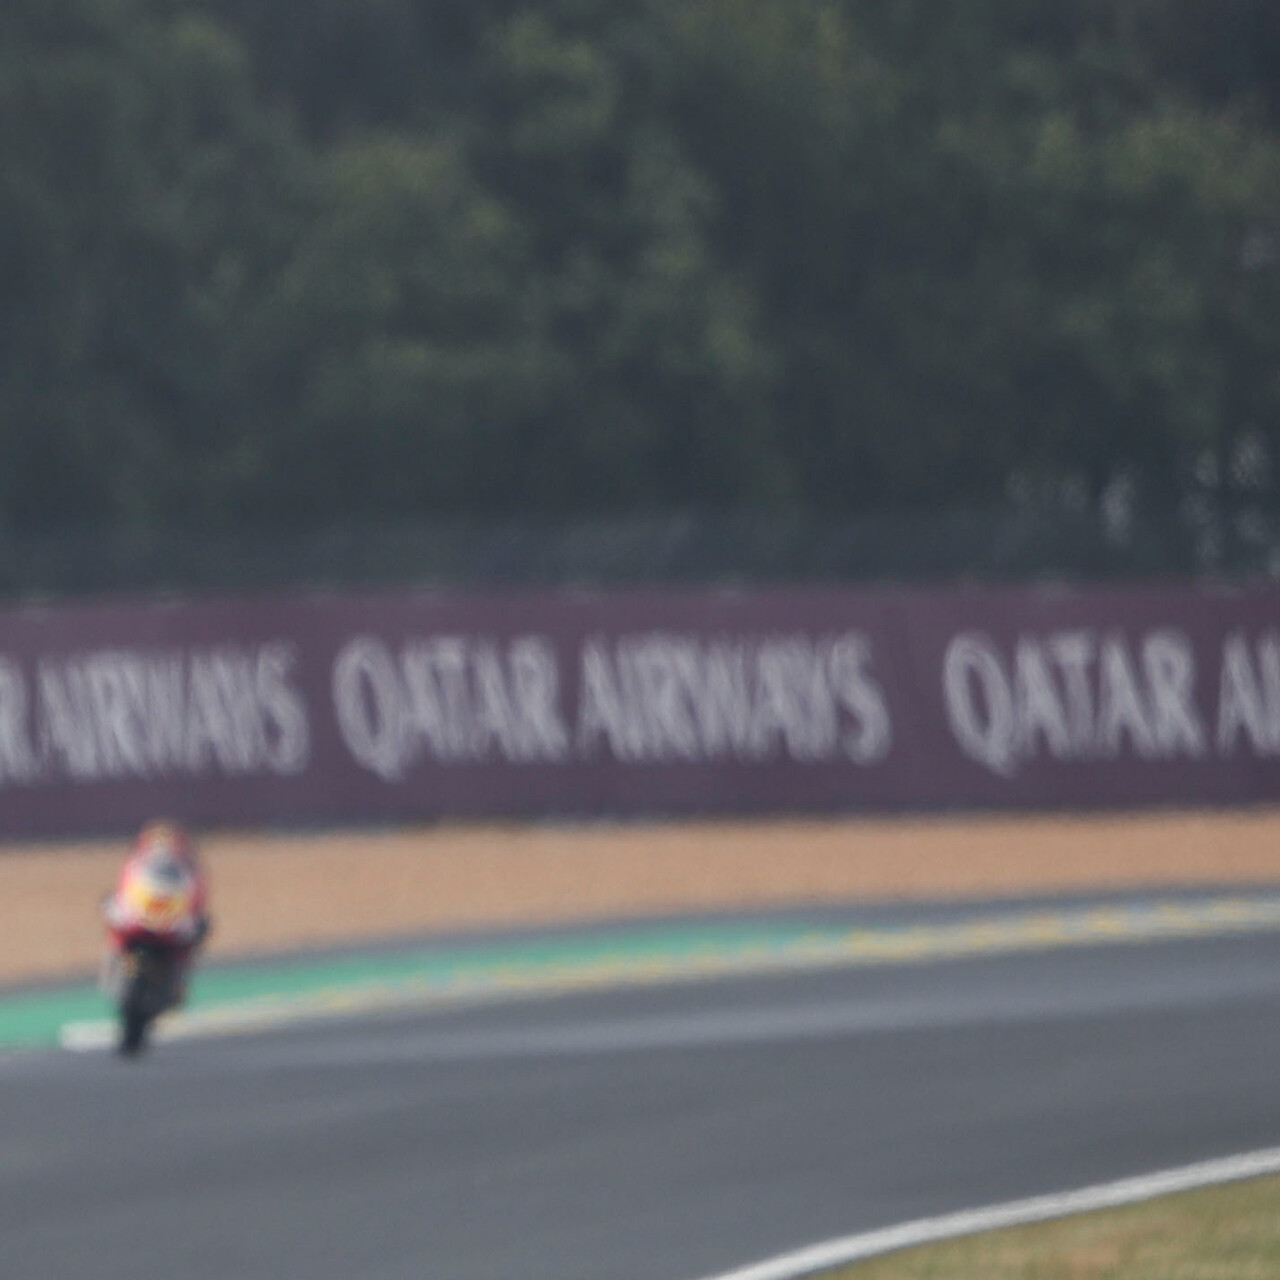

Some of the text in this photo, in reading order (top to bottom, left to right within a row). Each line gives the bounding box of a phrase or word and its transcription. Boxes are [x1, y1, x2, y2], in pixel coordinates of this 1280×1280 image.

[39, 640, 310, 782] AIRWAYS
[332, 631, 892, 781] QATAR AIRWAYS
[943, 630, 1207, 776] QATAR
